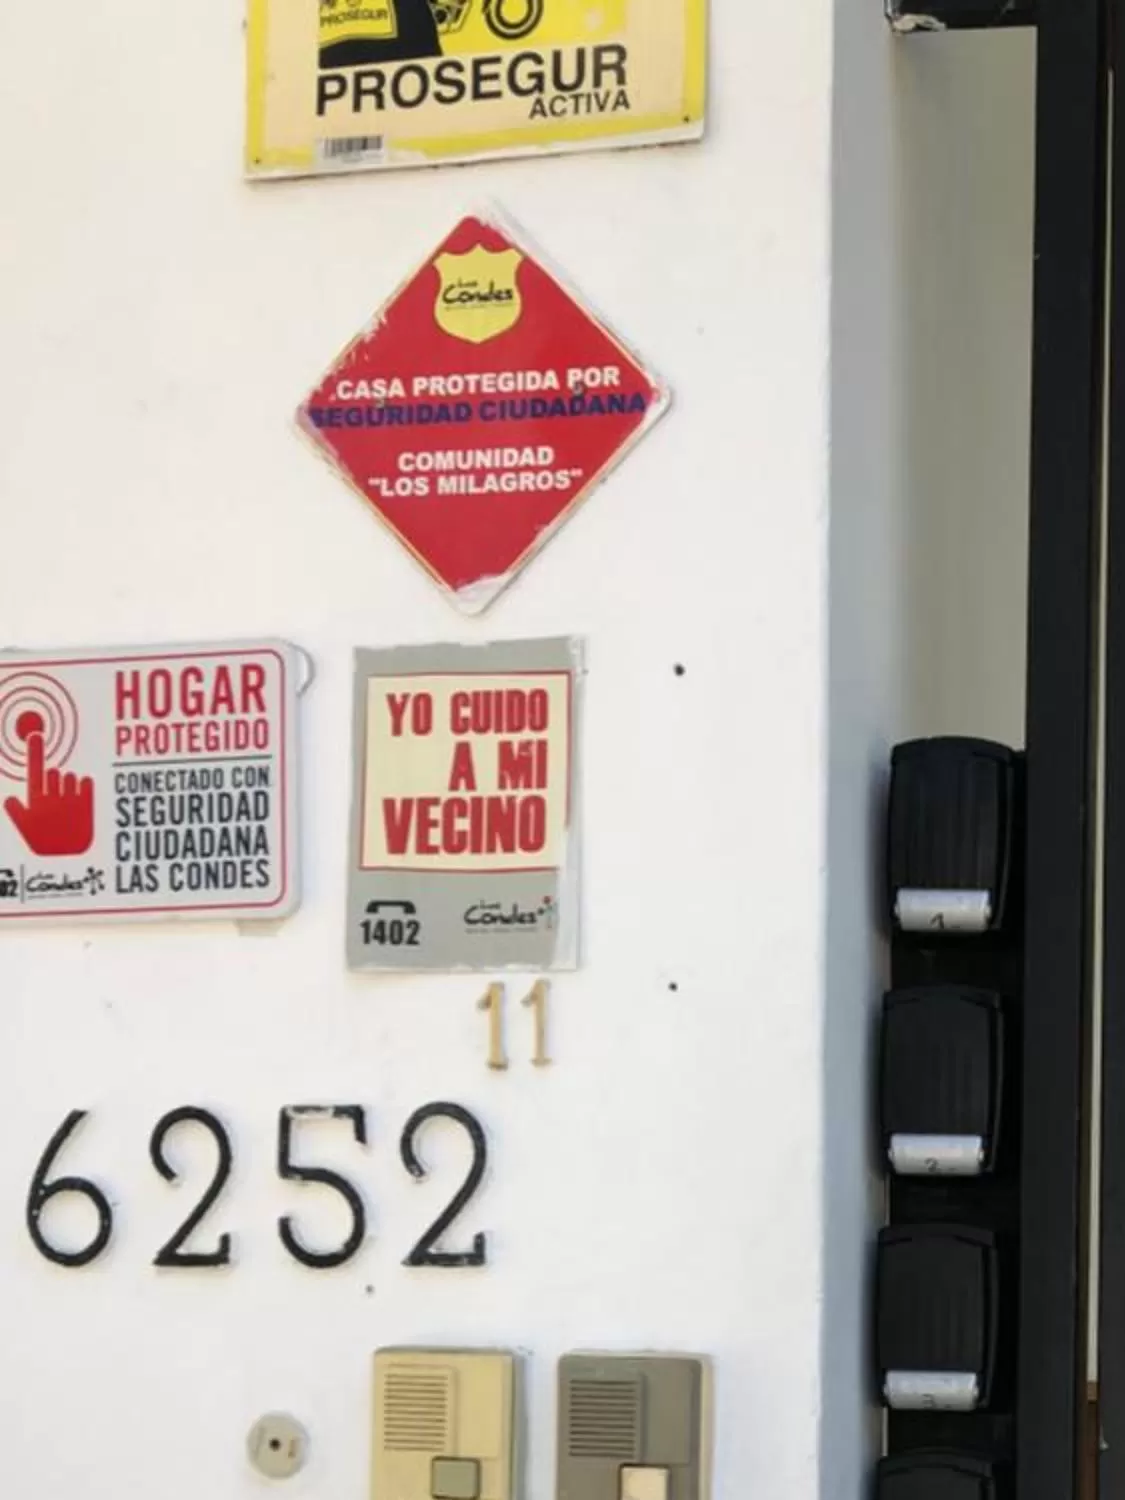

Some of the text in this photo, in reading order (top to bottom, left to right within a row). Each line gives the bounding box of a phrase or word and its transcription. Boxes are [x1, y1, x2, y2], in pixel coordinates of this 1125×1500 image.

[316, 44, 628, 116] PROSEGUR
[528, 90, 630, 119] ACTIVA
[442, 280, 514, 304] Condes
[336, 366, 620, 399] CASA PROTEGIDA POR
[311, 391, 647, 429] SEGURIDAD CIUDADANA
[398, 446, 555, 472] COMUNIDAD
[370, 468, 582, 497] "LOS MILAGROS"
[115, 663, 267, 720] HOGAR
[386, 688, 549, 737] YO CUIDO
[115, 718, 270, 756] PROTEGIDO
[114, 766, 270, 795] CONECTADO CON
[448, 739, 548, 791] A MI
[115, 790, 270, 828] SEGURIDAD
[383, 795, 547, 855] VECINO
[115, 825, 270, 862] CIUDADANA
[115, 859, 271, 894] LAS CONDES
[463, 902, 536, 925] Condes
[360, 919, 420, 946] 1402
[477, 980, 552, 1069] 11
[26, 1101, 487, 1268] 6252
